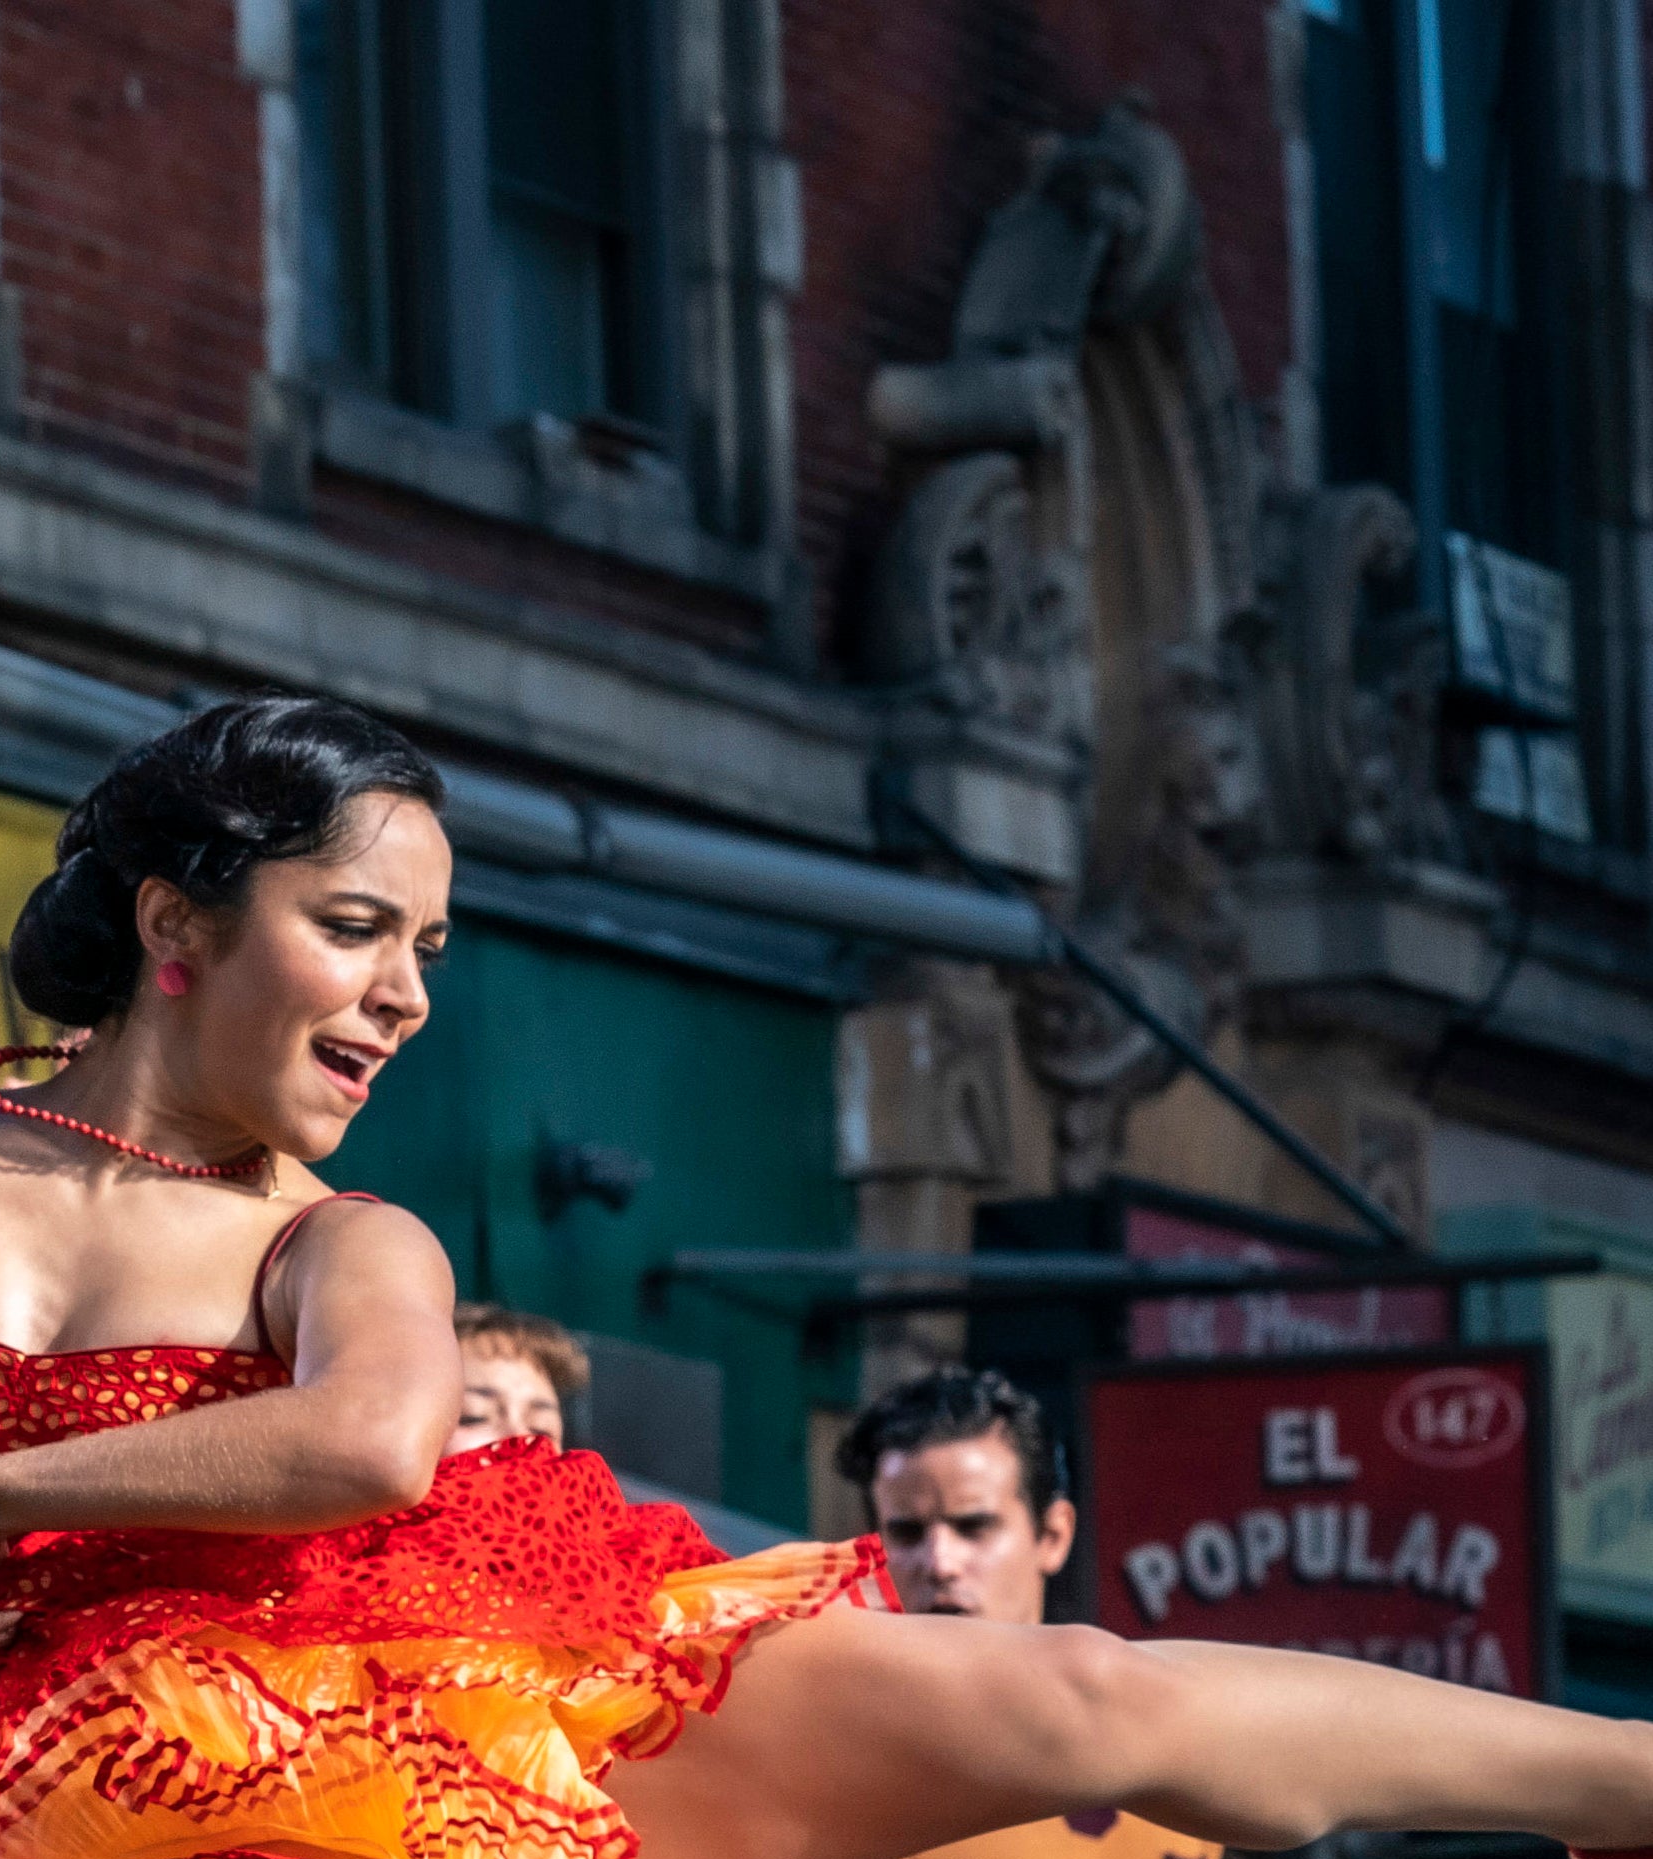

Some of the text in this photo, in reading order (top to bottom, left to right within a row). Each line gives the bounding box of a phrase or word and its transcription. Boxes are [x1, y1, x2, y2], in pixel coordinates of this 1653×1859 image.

[1262, 1405, 1358, 1487] EL
[1415, 1388, 1497, 1442] 147
[1124, 1501, 1501, 1623] POPULAR
